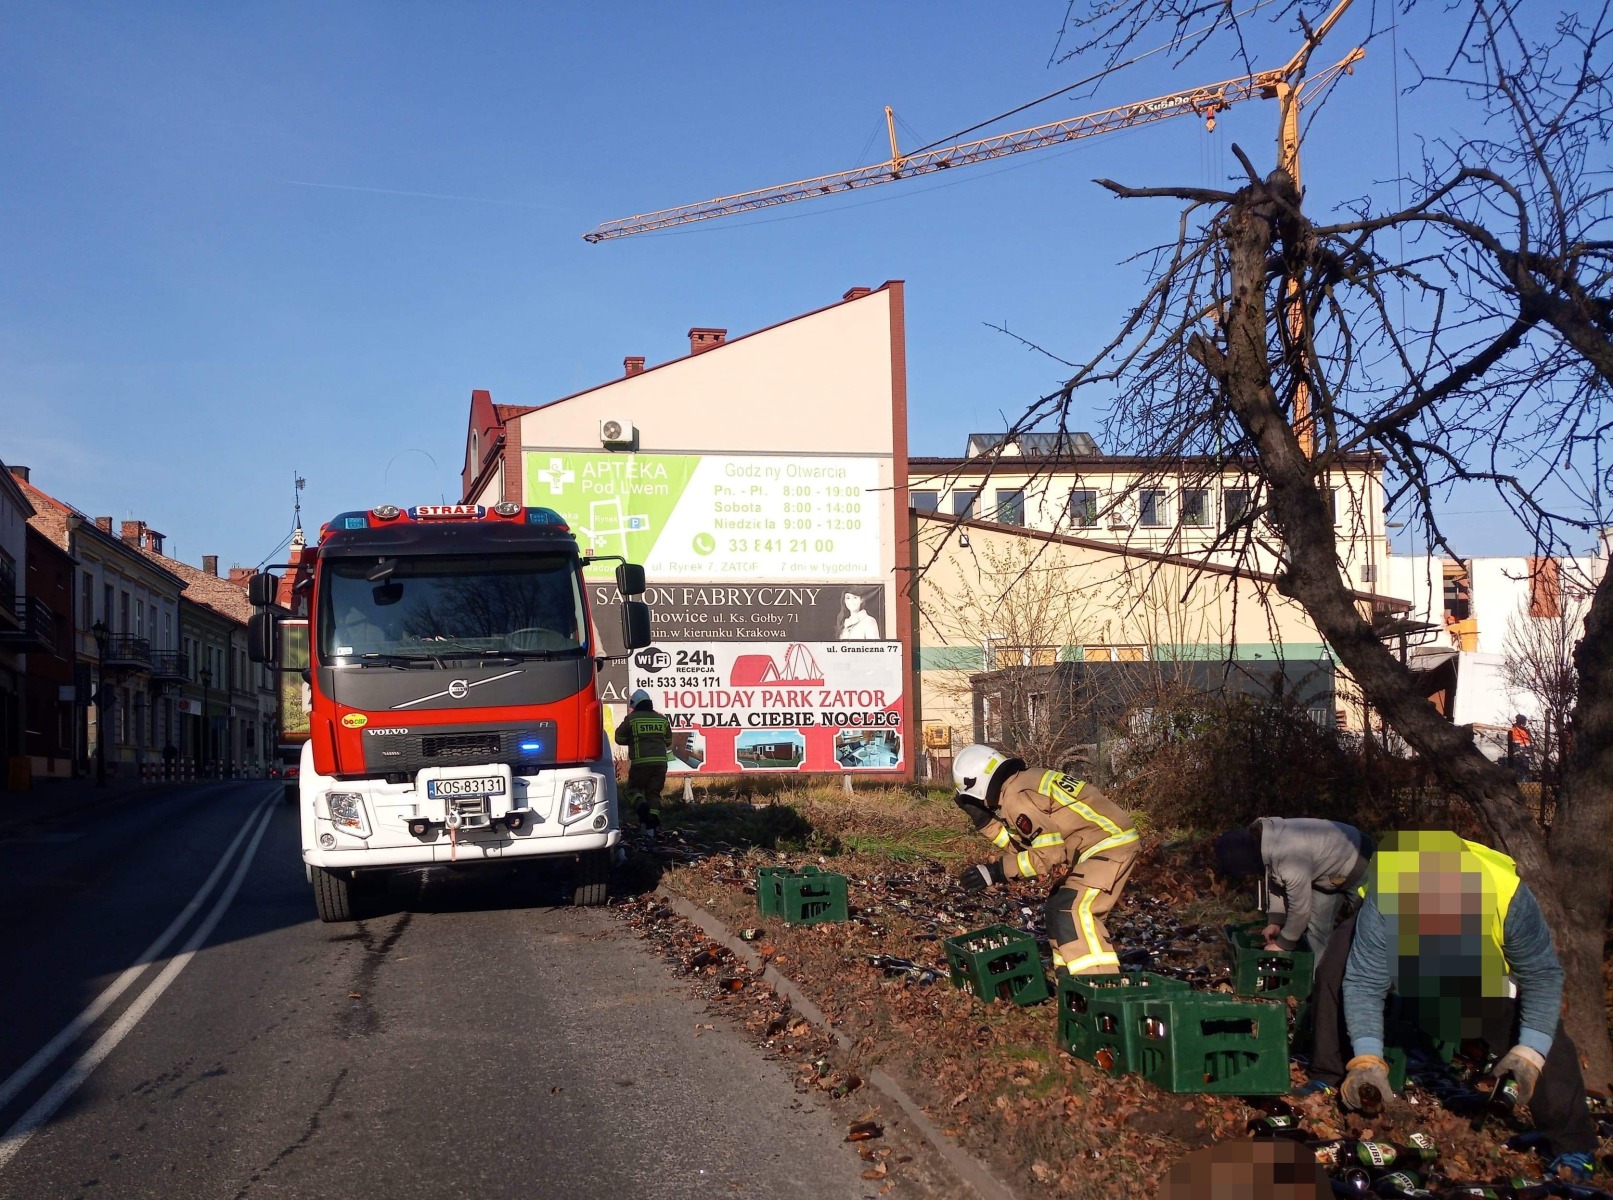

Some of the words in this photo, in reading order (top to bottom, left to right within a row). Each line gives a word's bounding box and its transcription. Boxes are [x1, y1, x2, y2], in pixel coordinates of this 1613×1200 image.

[582, 461, 668, 479] APTEKA
[725, 463, 781, 480] Godzny
[786, 464, 847, 478] Otwarcia
[581, 480, 615, 494] Pod
[621, 481, 669, 495] Lwem
[714, 485, 736, 496] Pn.
[783, 485, 811, 496] 8:00
[826, 486, 860, 497] 19:00
[714, 502, 762, 512] Sobota
[784, 502, 811, 513] 8:00
[826, 503, 861, 513] 14:00
[784, 519, 812, 529] 9:00
[826, 519, 861, 530] 12:00
[729, 539, 748, 552] 33
[790, 539, 807, 552] 21
[815, 539, 834, 552] 00
[682, 587, 821, 606] FABRYCZNY
[713, 613, 726, 623] ul.
[730, 613, 748, 623] Ks.
[751, 613, 784, 625] Gołby
[787, 613, 799, 623] 71
[684, 627, 733, 638] kierunku
[736, 627, 786, 638] Krakowa
[826, 645, 838, 653] ul.
[841, 645, 885, 653] Graniczna
[887, 645, 898, 653] 77
[676, 650, 715, 666] 24h
[636, 677, 654, 687] tel:
[657, 677, 677, 687] 533
[680, 677, 699, 687] 343
[702, 676, 720, 687] 171
[663, 690, 755, 709] HOLIDAY
[761, 690, 814, 708] PARK
[819, 689, 887, 708] ZATOR
[701, 713, 742, 728] DLA
[747, 712, 815, 727] CIEBIE
[821, 711, 900, 726] NOCLEG
[367, 728, 409, 736] VOLVO
[435, 781, 460, 795] KOS
[464, 778, 501, 793] 83131
